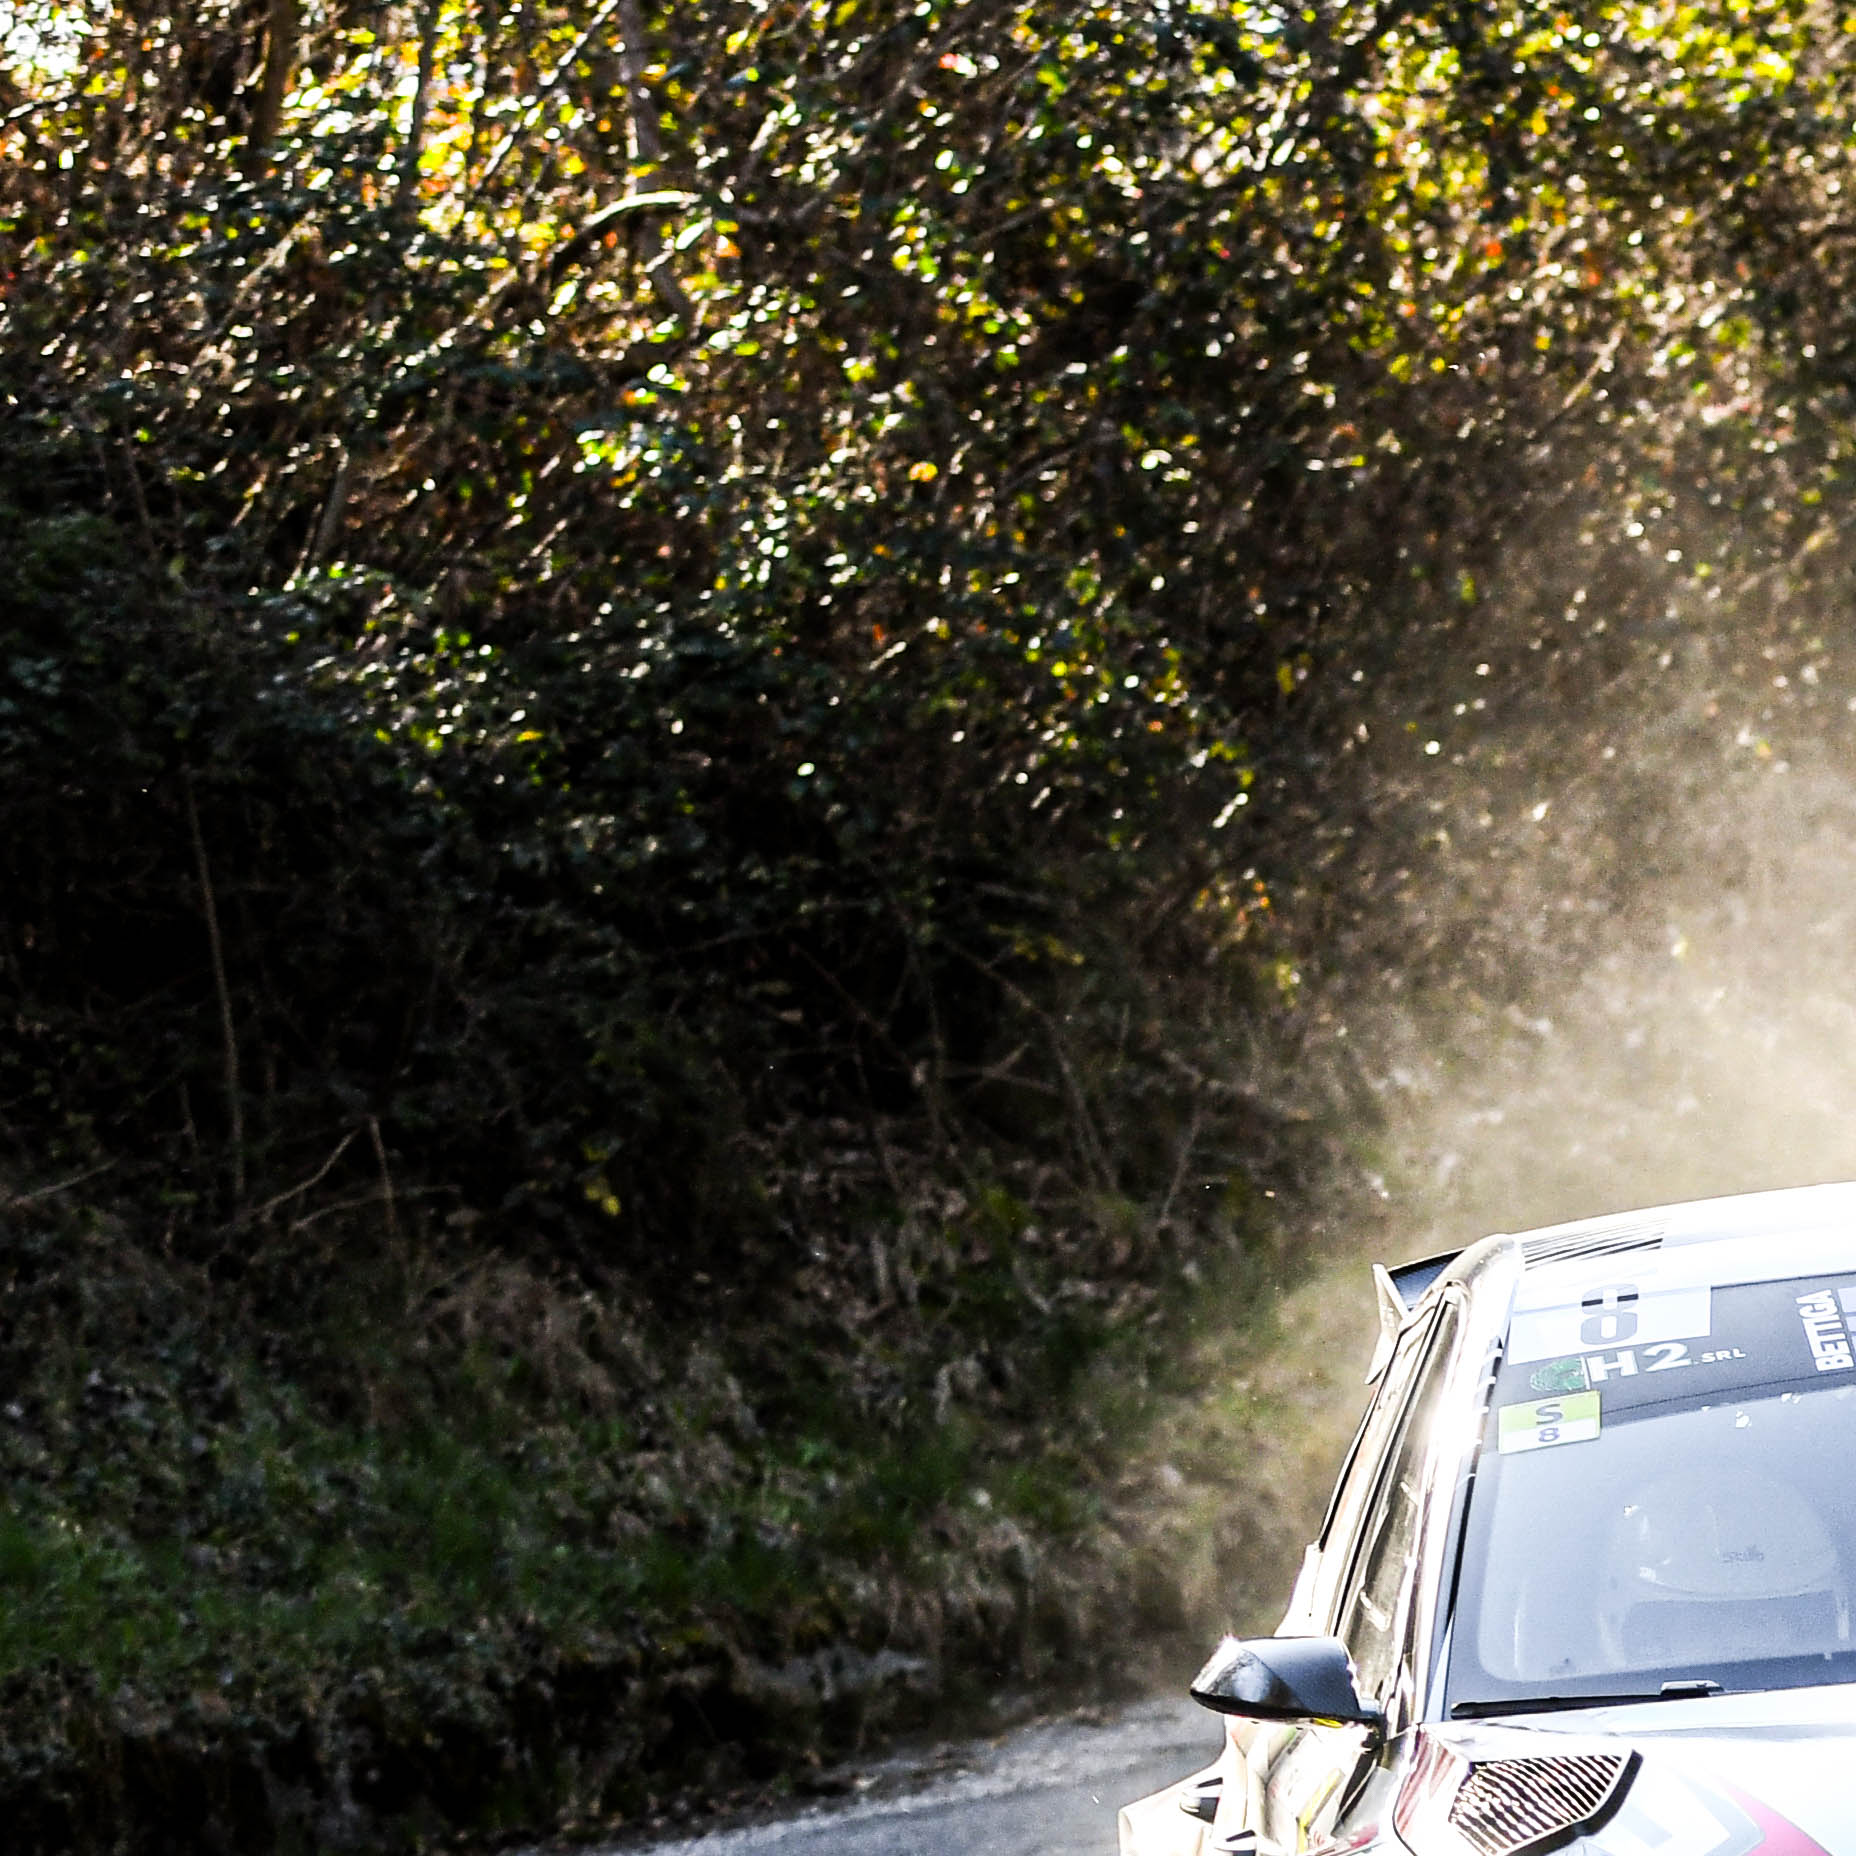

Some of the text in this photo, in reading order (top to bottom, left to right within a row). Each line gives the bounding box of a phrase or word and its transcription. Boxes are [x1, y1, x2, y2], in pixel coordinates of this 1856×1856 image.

[1580, 1283, 1639, 1345] 8
[1795, 1288, 1855, 1372] BETTIGA
[1535, 1403, 1565, 1426] S
[1537, 1427, 1561, 1443] 8
